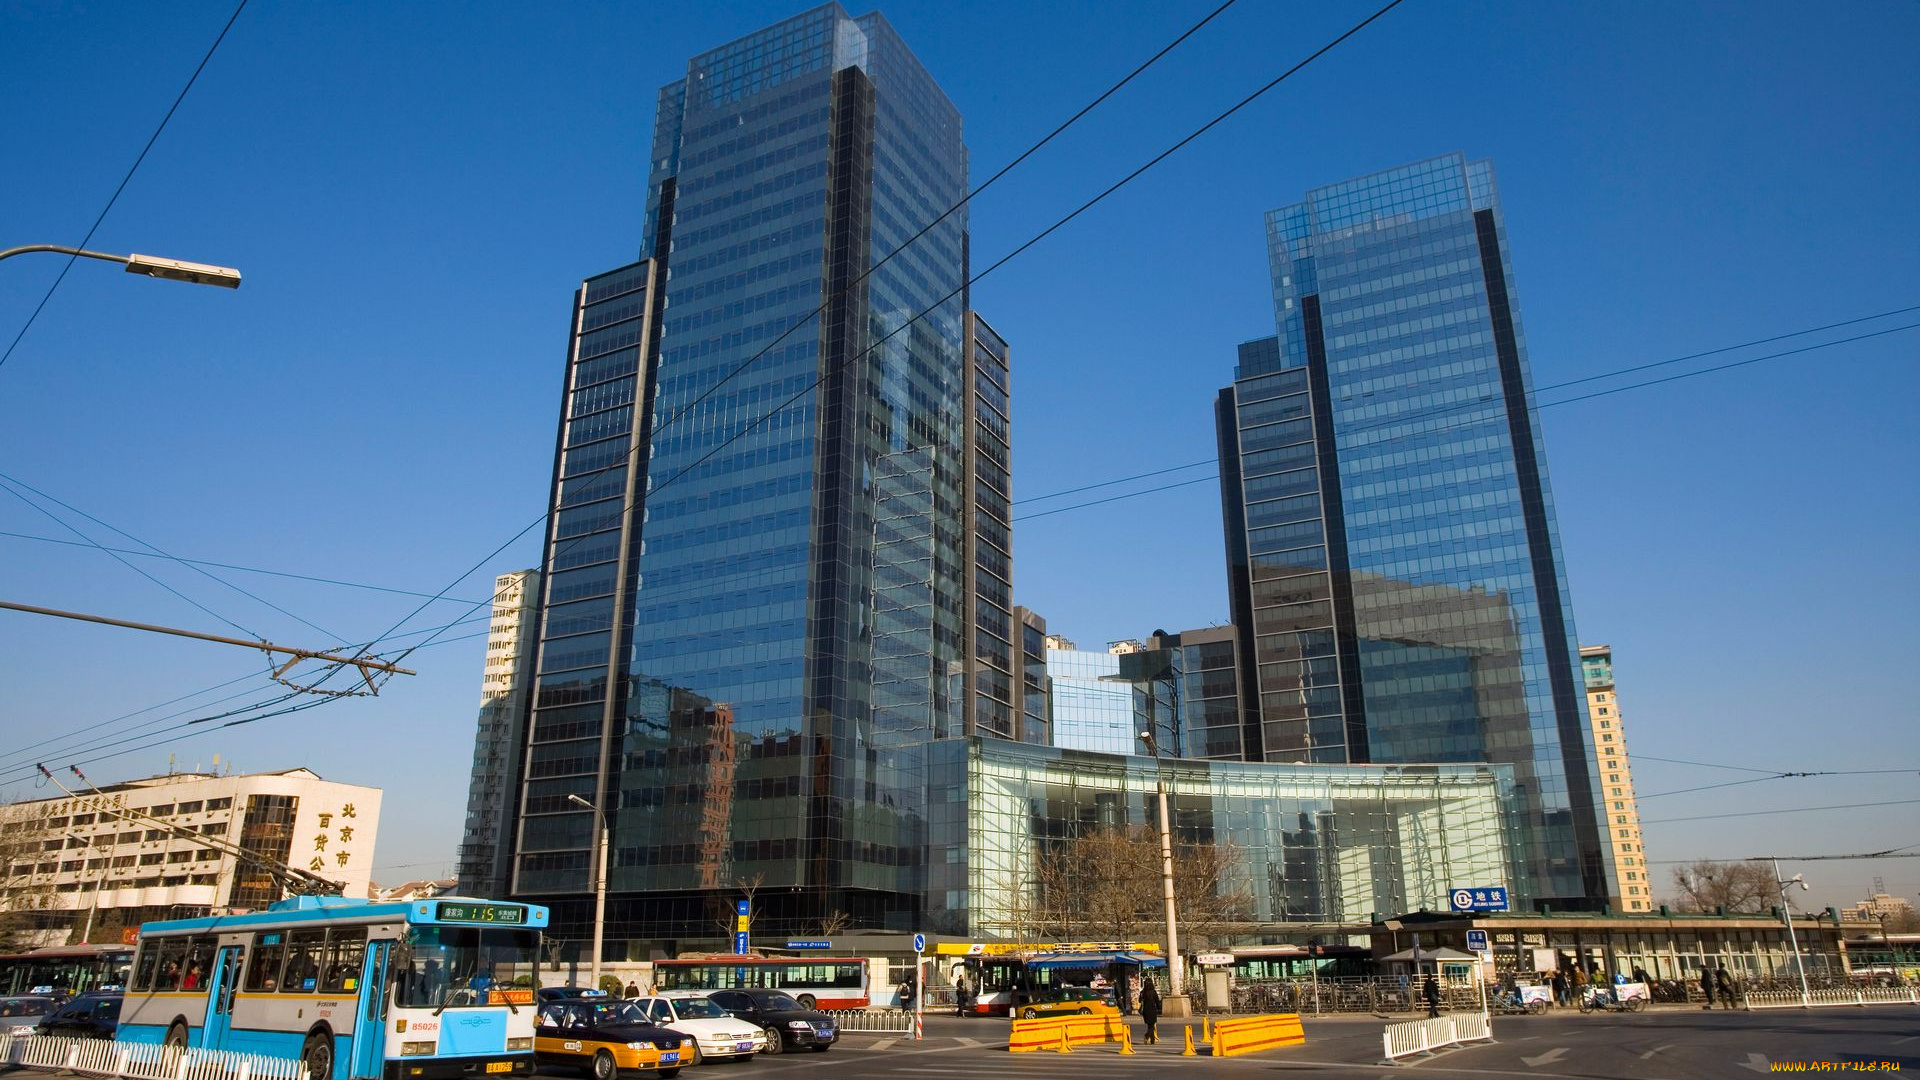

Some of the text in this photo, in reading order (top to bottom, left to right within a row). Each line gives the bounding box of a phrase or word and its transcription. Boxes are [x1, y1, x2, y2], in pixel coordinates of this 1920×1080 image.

[336, 803, 356, 868] 北京市
[309, 813, 333, 871] 百货公
[1476, 891, 1501, 901] 地铁
[472, 908, 494, 921] 115
[1617, 975, 1624, 984] P
[412, 1023, 438, 1031] 85026
